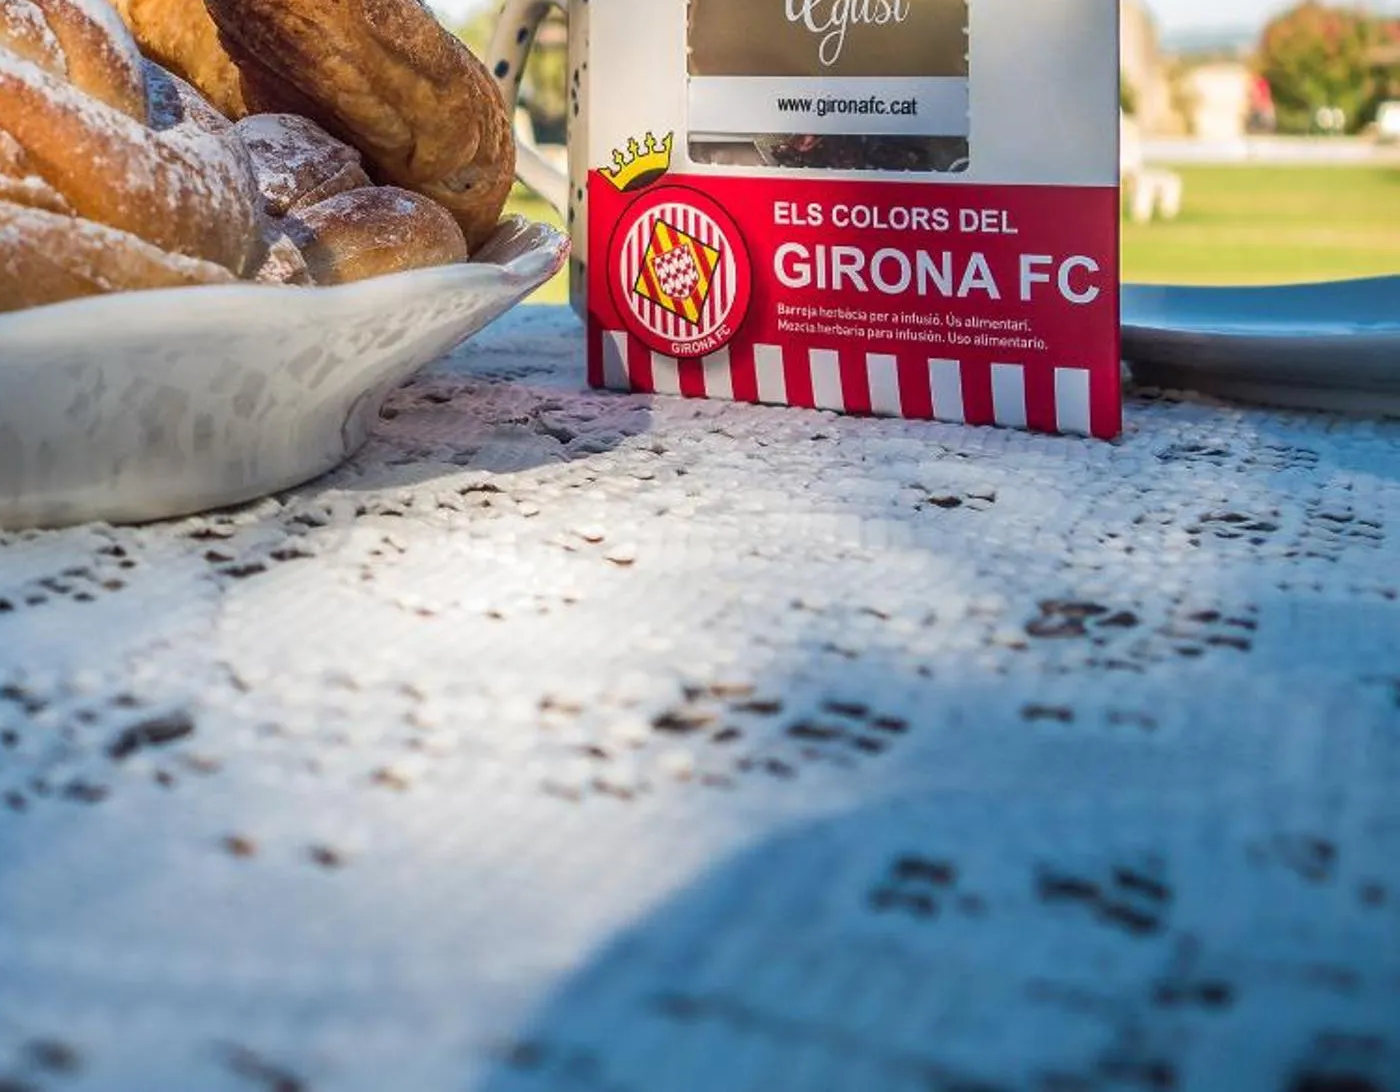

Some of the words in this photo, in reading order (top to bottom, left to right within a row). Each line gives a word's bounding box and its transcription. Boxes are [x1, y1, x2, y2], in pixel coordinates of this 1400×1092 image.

[777, 95, 918, 117] www.gironafc.cat
[773, 201, 823, 226] ELS
[831, 204, 950, 233] COLORS
[959, 209, 1018, 234] DEL
[773, 242, 1001, 300] GIRONA
[1018, 253, 1101, 304] FC
[777, 303, 818, 320] Barreja
[869, 311, 890, 324] per
[891, 313, 899, 324] a
[900, 311, 944, 326] infusió.
[945, 311, 962, 328] Ús
[964, 315, 1033, 332] alimentari.
[671, 336, 717, 354] GIRONA
[714, 324, 731, 341] FC
[867, 327, 894, 340] para
[895, 328, 945, 343] infusión.
[947, 331, 972, 345] Uso
[973, 334, 1049, 351] alimentario.
